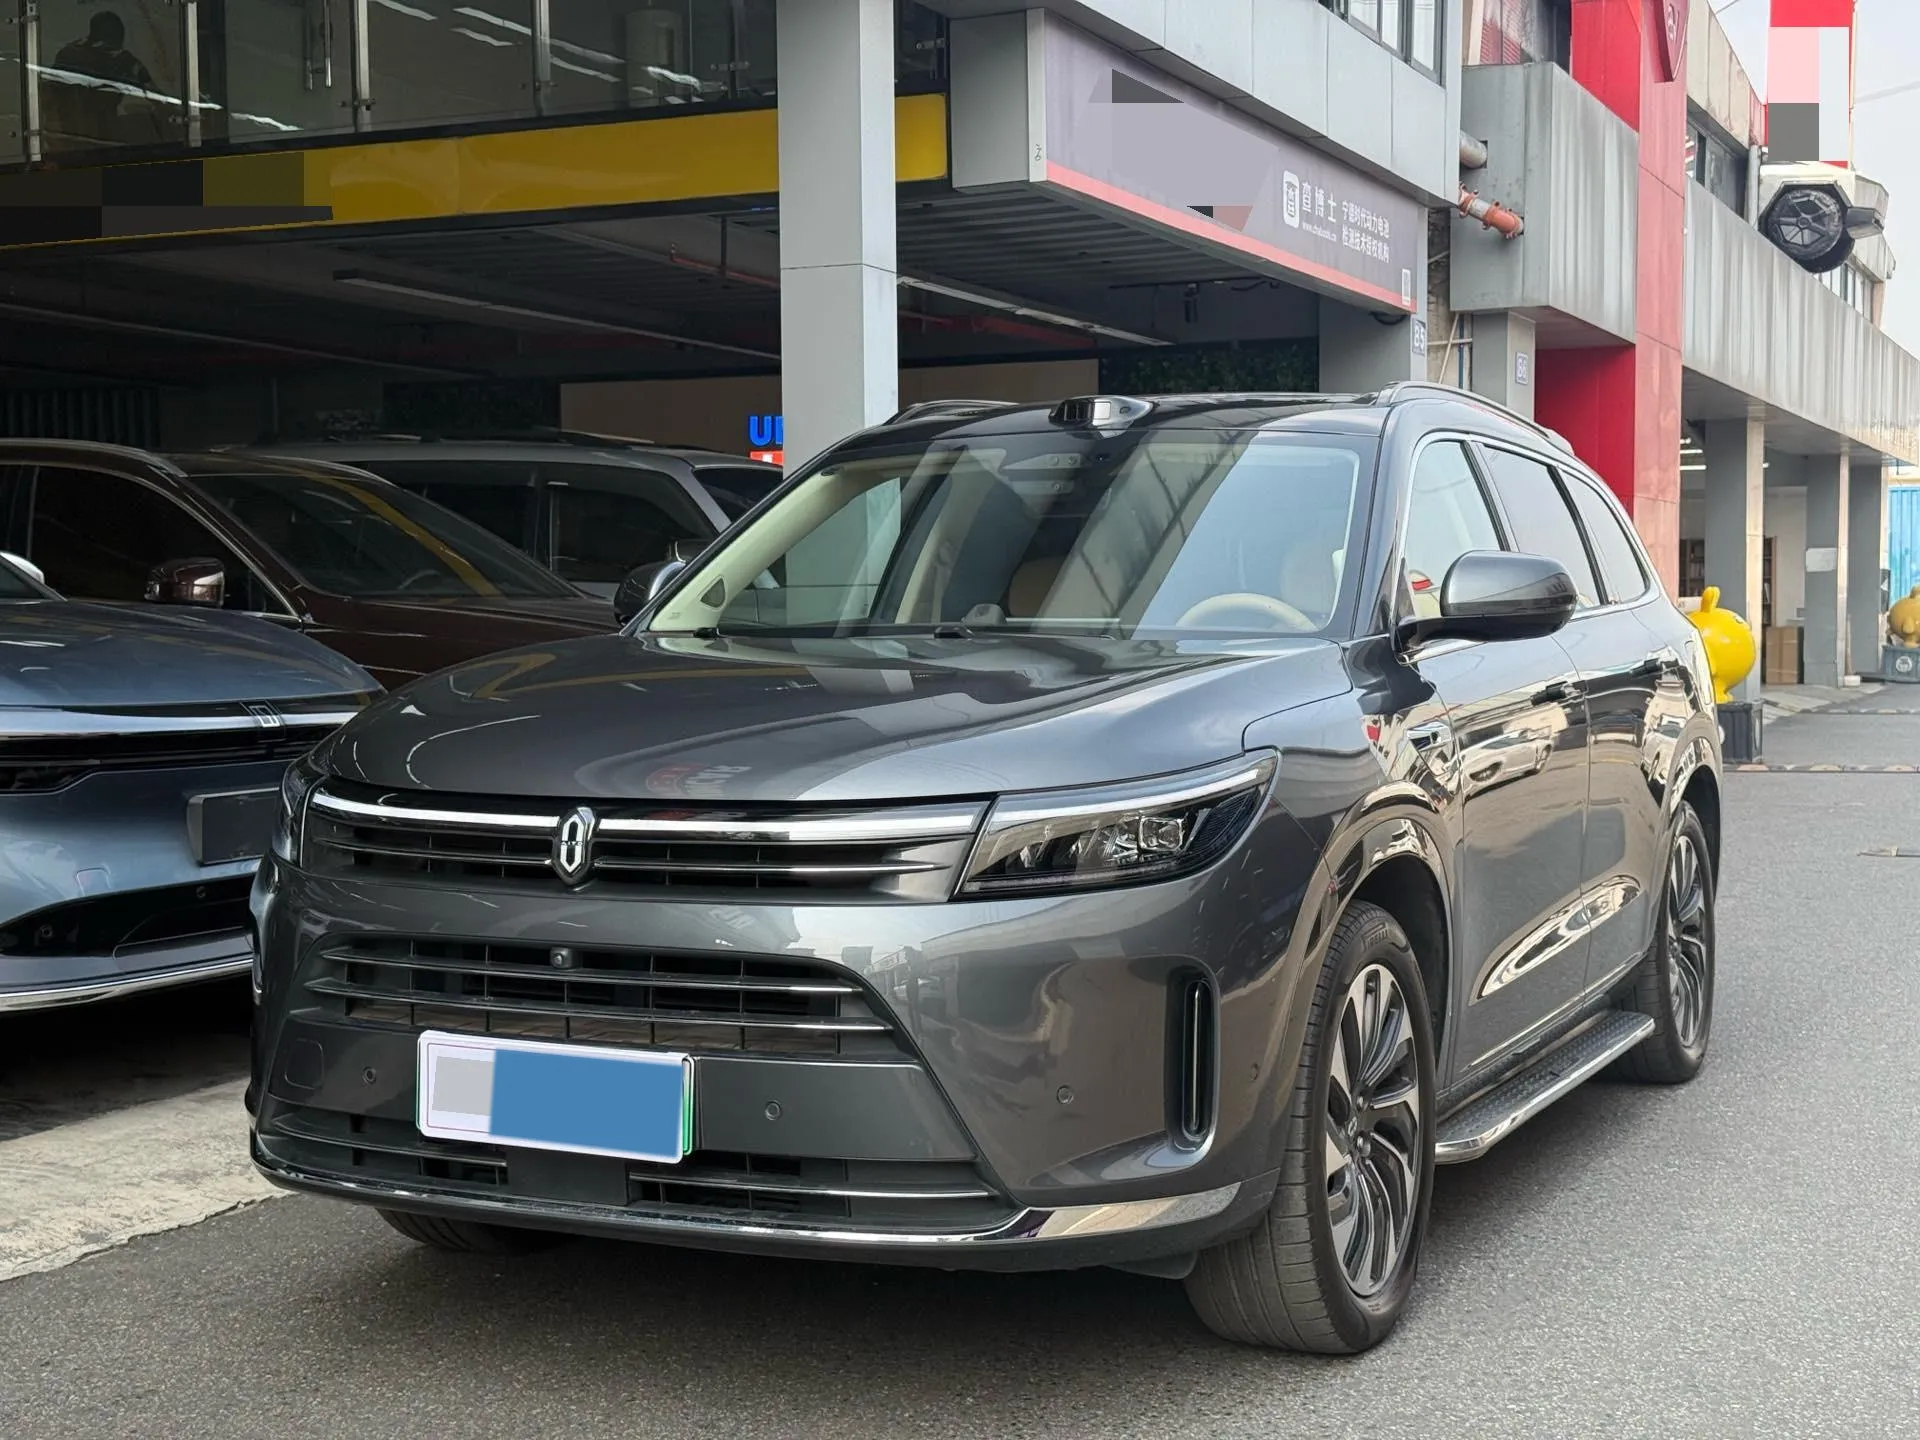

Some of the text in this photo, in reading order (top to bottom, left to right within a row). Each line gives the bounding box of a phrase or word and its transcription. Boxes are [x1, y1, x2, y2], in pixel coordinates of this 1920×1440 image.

[1302, 182, 1337, 223] 查博士
[1414, 325, 1425, 350] B5
